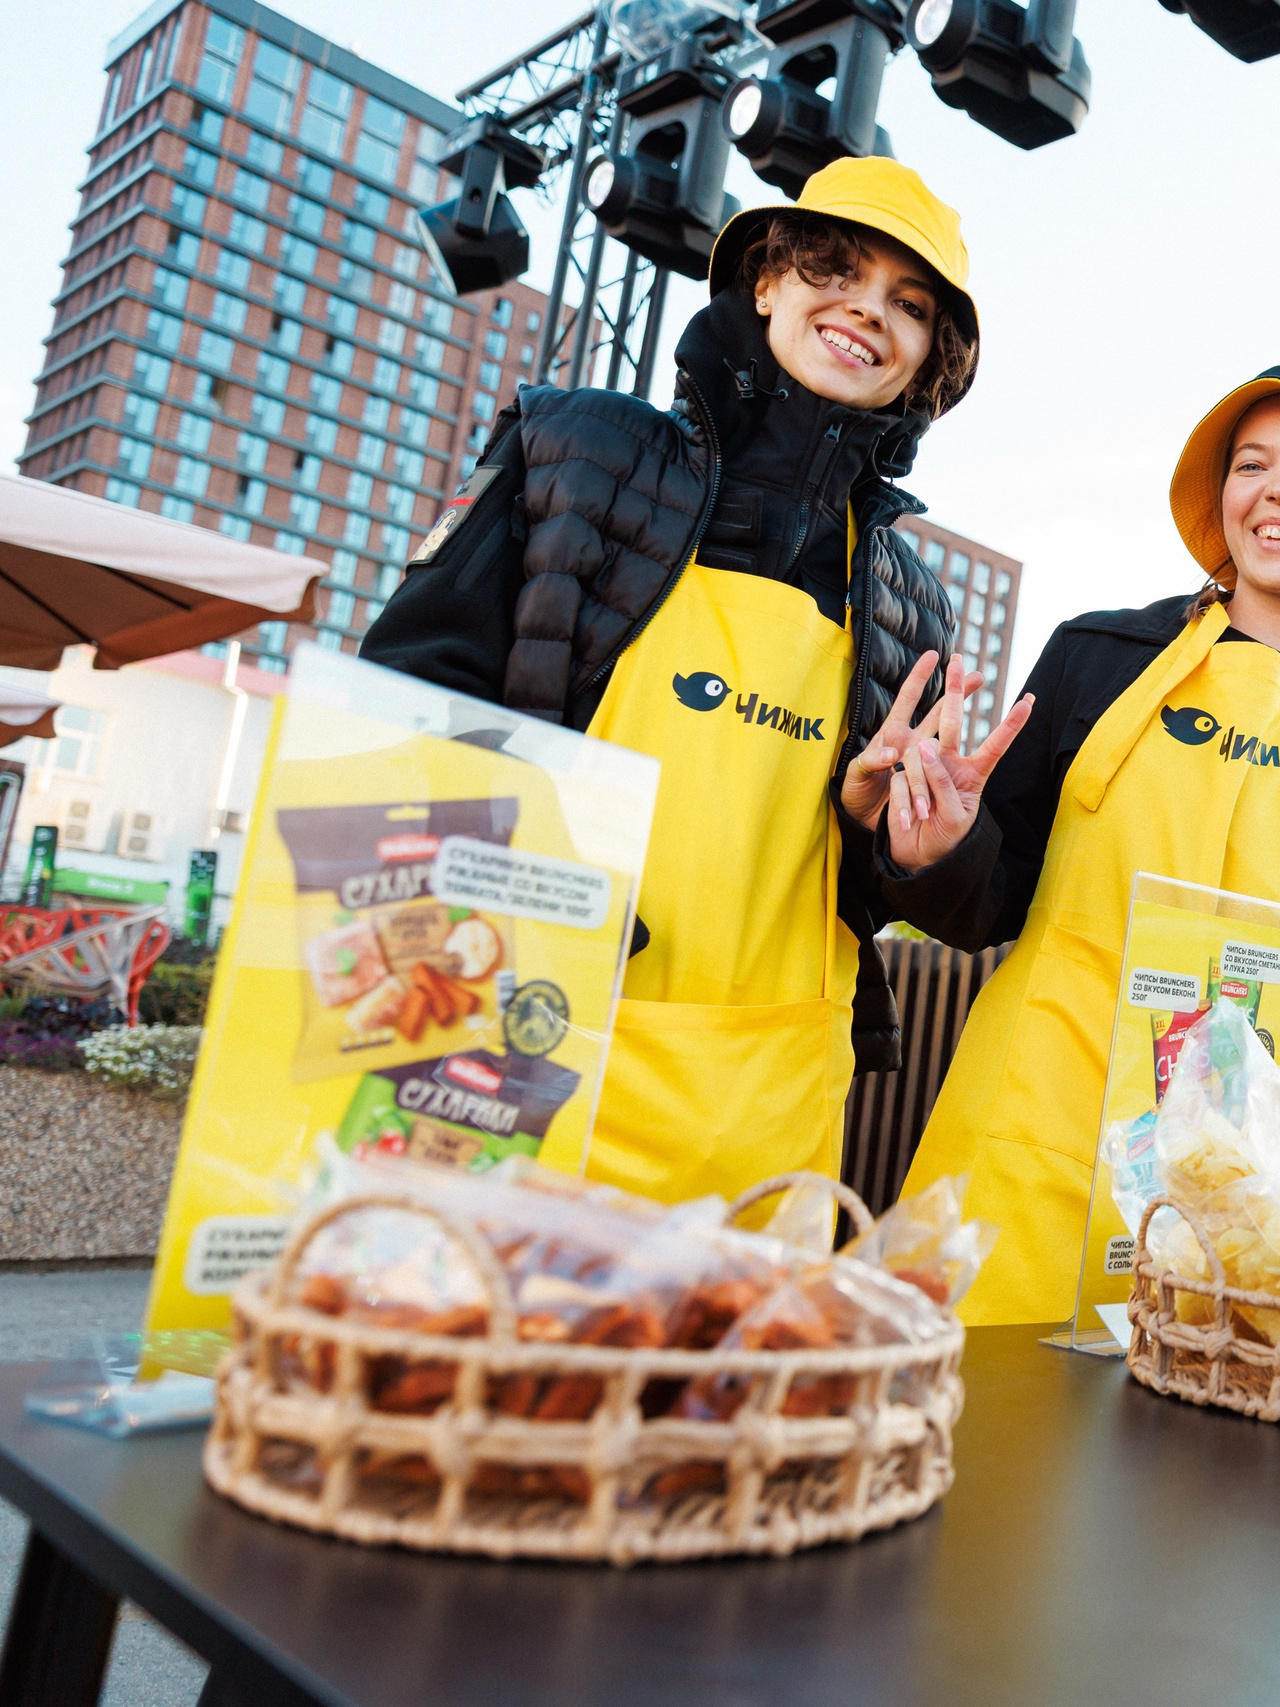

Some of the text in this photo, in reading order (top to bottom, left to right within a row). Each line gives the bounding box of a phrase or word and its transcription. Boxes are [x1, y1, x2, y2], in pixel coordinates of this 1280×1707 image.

[340, 863, 432, 907] СУХАР
[1227, 945, 1279, 961] ЧИПСЫ BRUNCHERS
[1225, 954, 1233, 962] СО
[1234, 956, 1258, 967] ВКУСОМ
[1229, 964, 1245, 974] ЛУКА
[1134, 973, 1195, 989] ЧИПСЫ BRUNCHERS
[1133, 982, 1196, 999] СО ВКУСОМ БЕКОНА
[1221, 984, 1248, 996] BRUNCHERS
[398, 1077, 521, 1132] СУХАРИКИ
[1110, 1241, 1135, 1249] ЧИПСЫ
[1113, 1260, 1133, 1269] СОЛЬ
